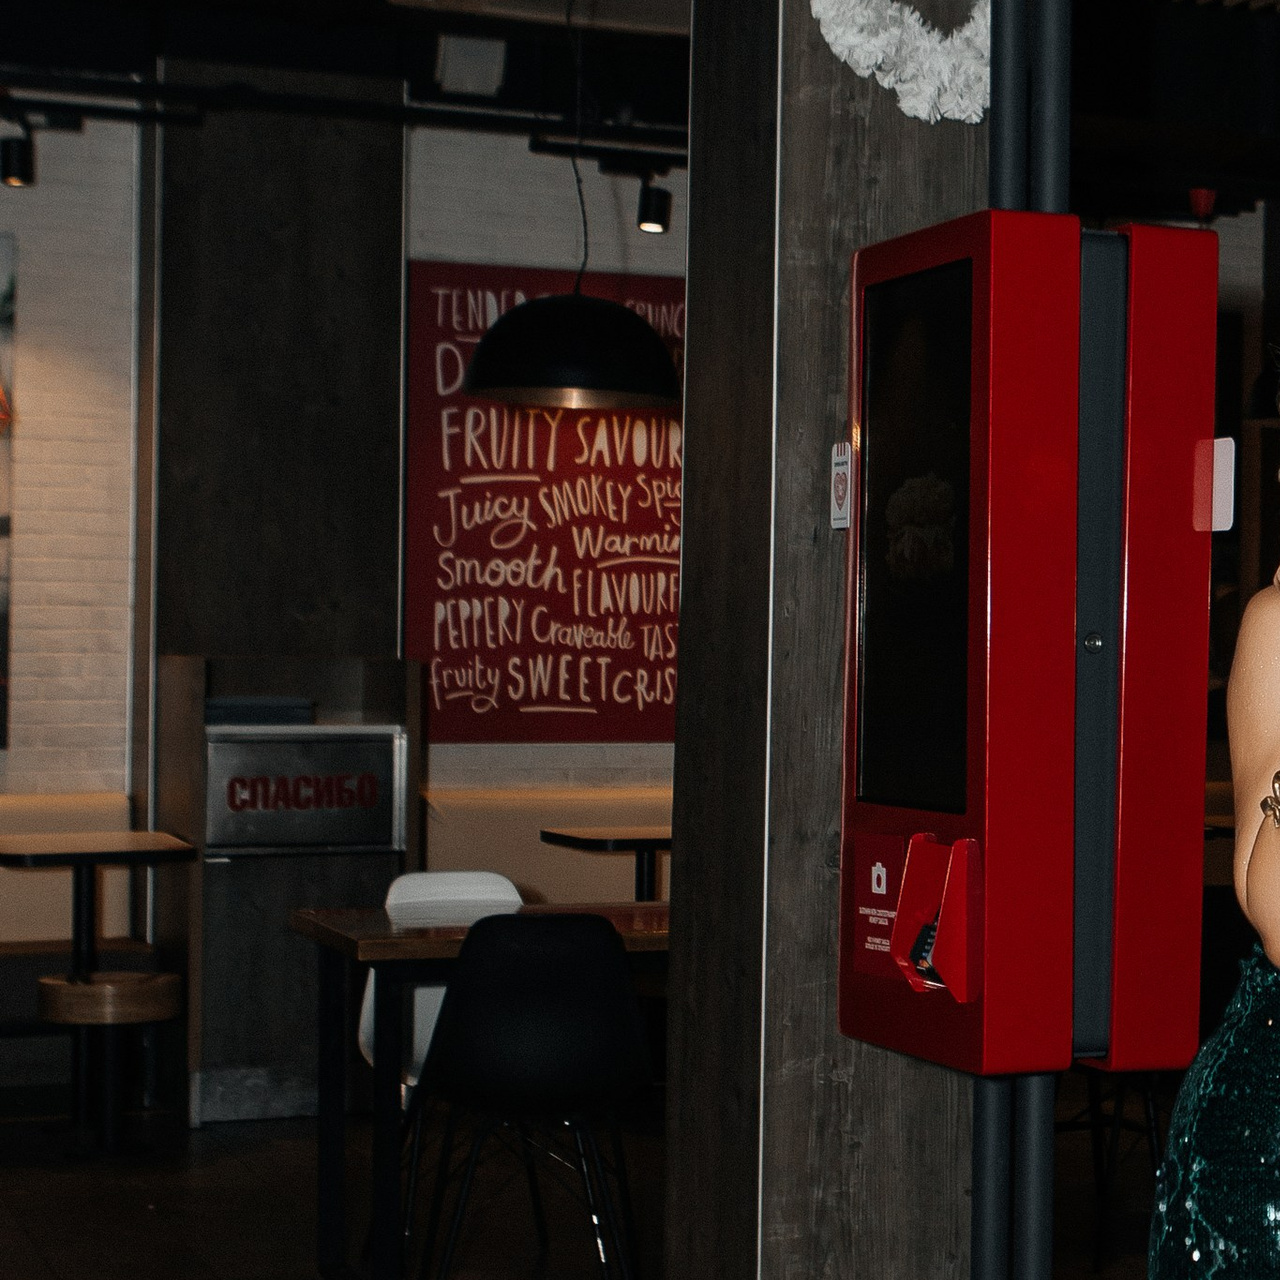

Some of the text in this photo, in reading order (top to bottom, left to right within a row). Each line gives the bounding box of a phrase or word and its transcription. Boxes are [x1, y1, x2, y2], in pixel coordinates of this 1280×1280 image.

[431, 288, 527, 331] TENDE
[440, 406, 564, 472] FRUITY
[433, 487, 538, 549] Juicy
[538, 474, 632, 529] SMOKEY
[436, 544, 567, 594] Smooth
[433, 596, 679, 662] PEPPERY Craveable TAS
[430, 654, 500, 714] fruity
[507, 654, 611, 702] SWEET
[226, 772, 379, 813] СПАСИБО
